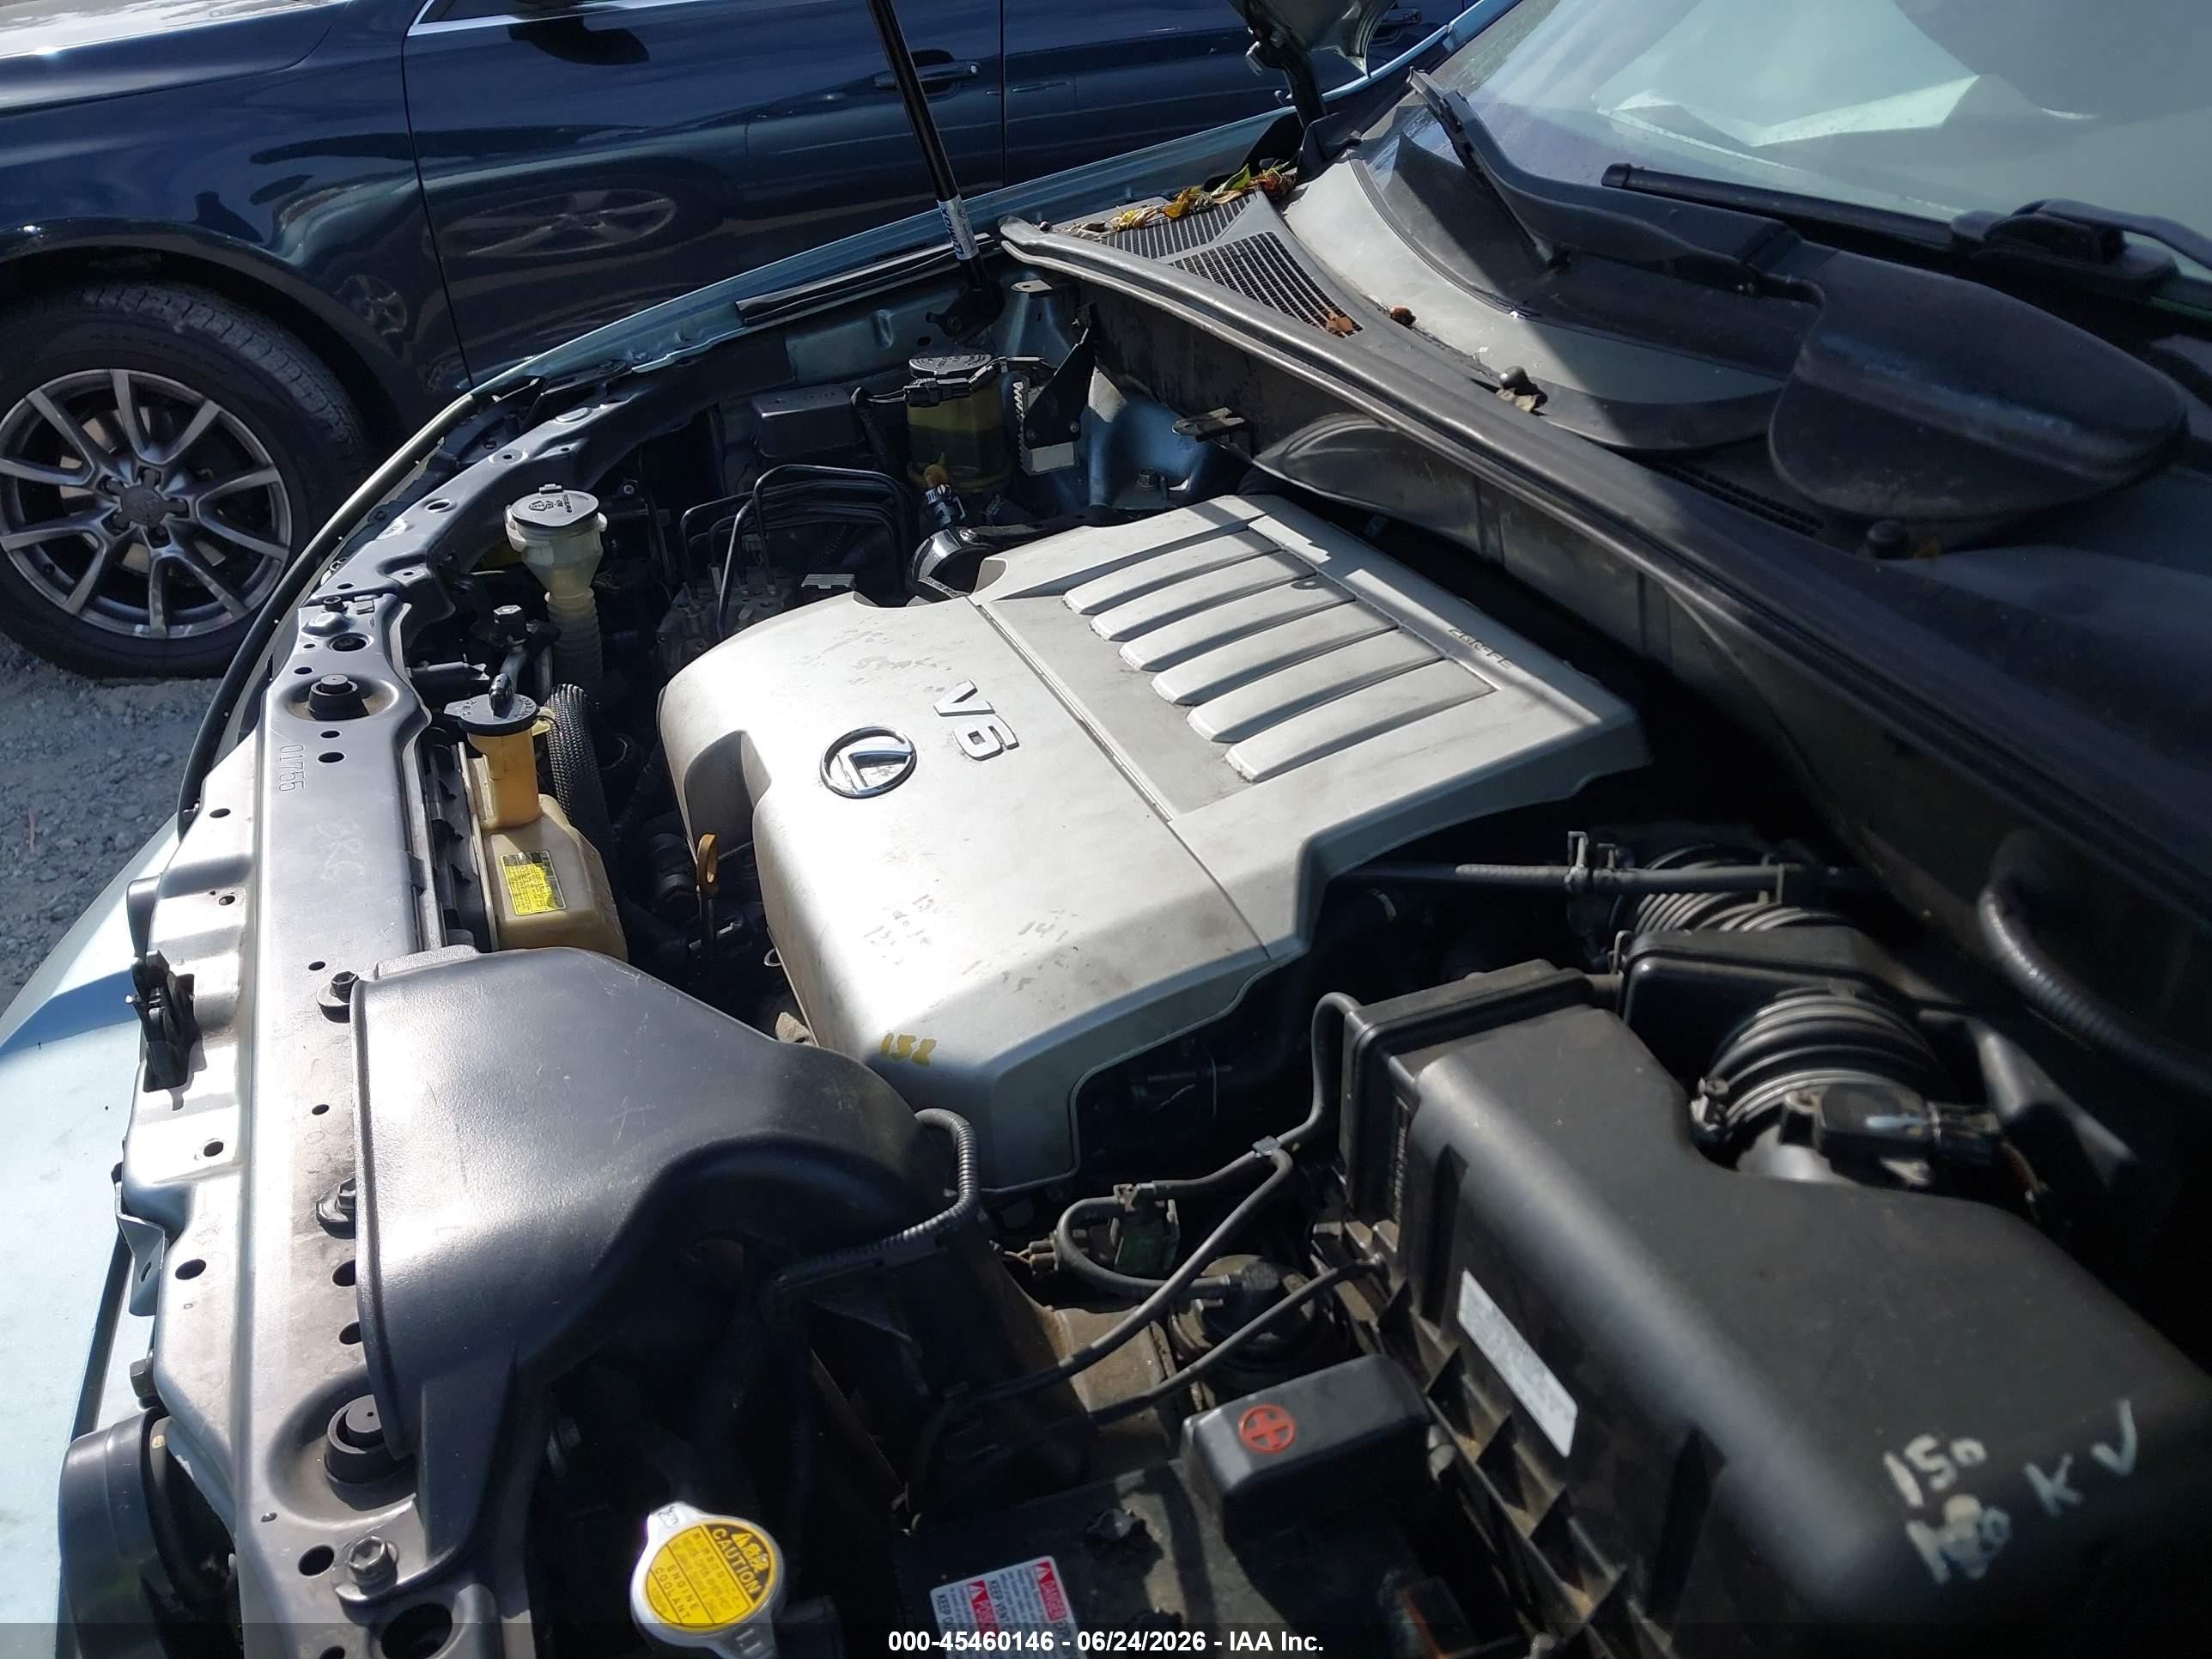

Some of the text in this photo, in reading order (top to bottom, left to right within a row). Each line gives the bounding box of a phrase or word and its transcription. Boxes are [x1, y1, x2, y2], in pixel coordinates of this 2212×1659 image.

[933, 679, 1019, 761] V6
[278, 744, 305, 792] 01755
[712, 1527, 762, 1595] CAUTION
[654, 1565, 692, 1620] COOLANT
[666, 1564, 701, 1611] ENGINE
[937, 1594, 951, 1615] KEEP
[989, 1579, 1004, 1600] KEEP
[1043, 1581, 1067, 1621] DANGER
